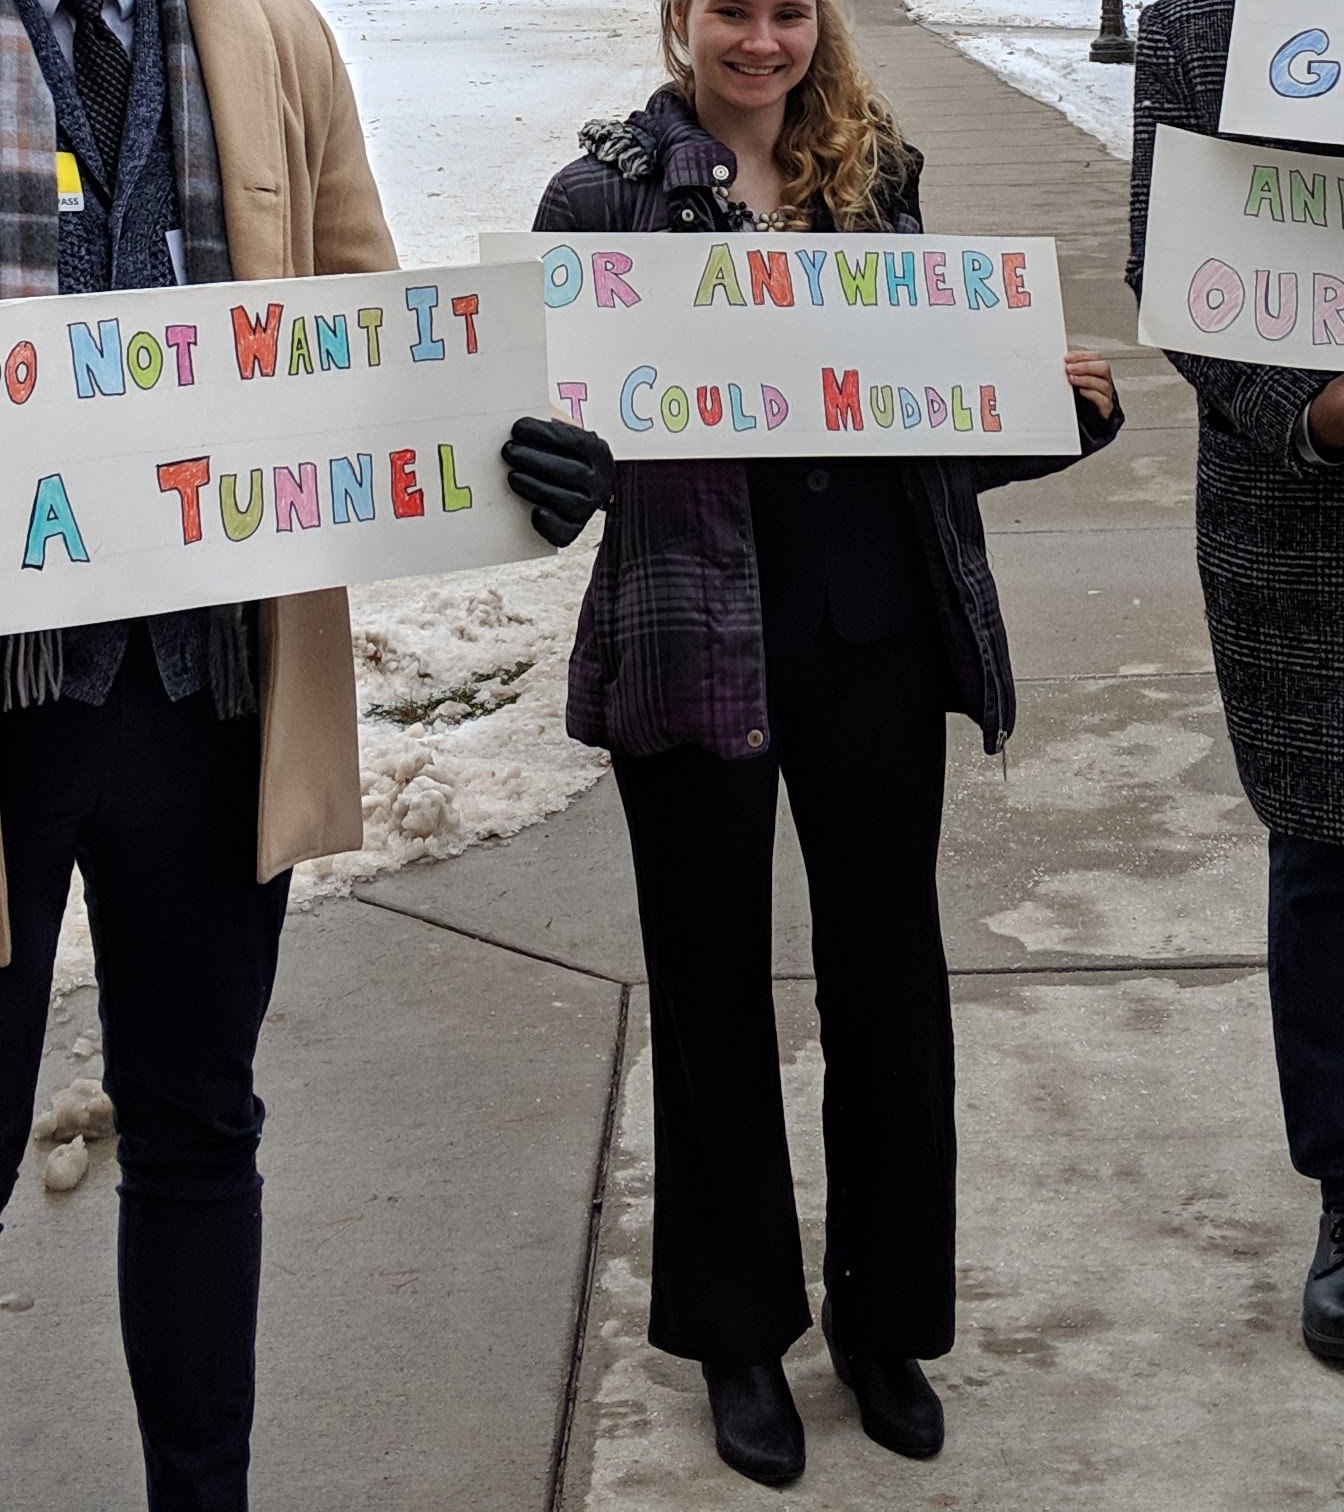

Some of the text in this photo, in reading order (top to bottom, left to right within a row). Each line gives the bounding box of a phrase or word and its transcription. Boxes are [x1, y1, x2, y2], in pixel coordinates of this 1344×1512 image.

[58, 197, 79, 205] ASS
[543, 243, 1032, 310] OR ANYWHERE
[67, 317, 197, 399] NOT
[230, 303, 383, 380] WANT
[405, 285, 479, 362] IT
[556, 365, 1002, 434] T COULD MUDDLE
[21, 473, 90, 570] A
[156, 444, 472, 545] TUNNEL
